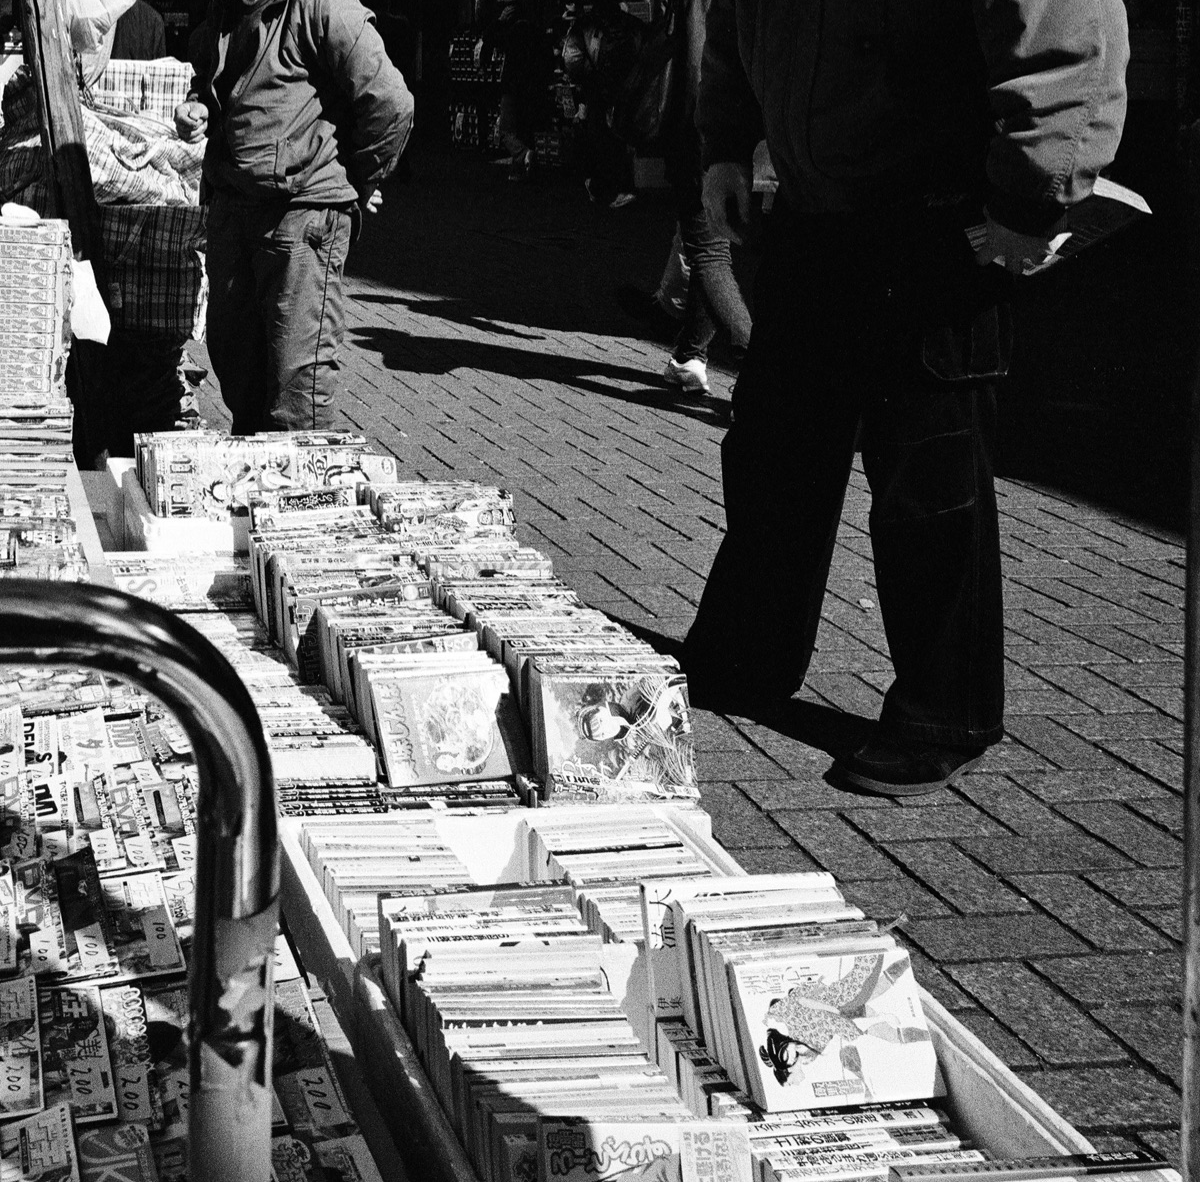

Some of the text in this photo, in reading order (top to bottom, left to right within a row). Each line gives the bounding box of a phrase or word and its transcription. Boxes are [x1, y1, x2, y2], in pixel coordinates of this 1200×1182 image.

[84, 933, 100, 956] 100
[155, 922, 167, 940] 100
[8, 1065, 24, 1092] 200
[121, 1076, 141, 1111] 200
[303, 1077, 333, 1111] 200
